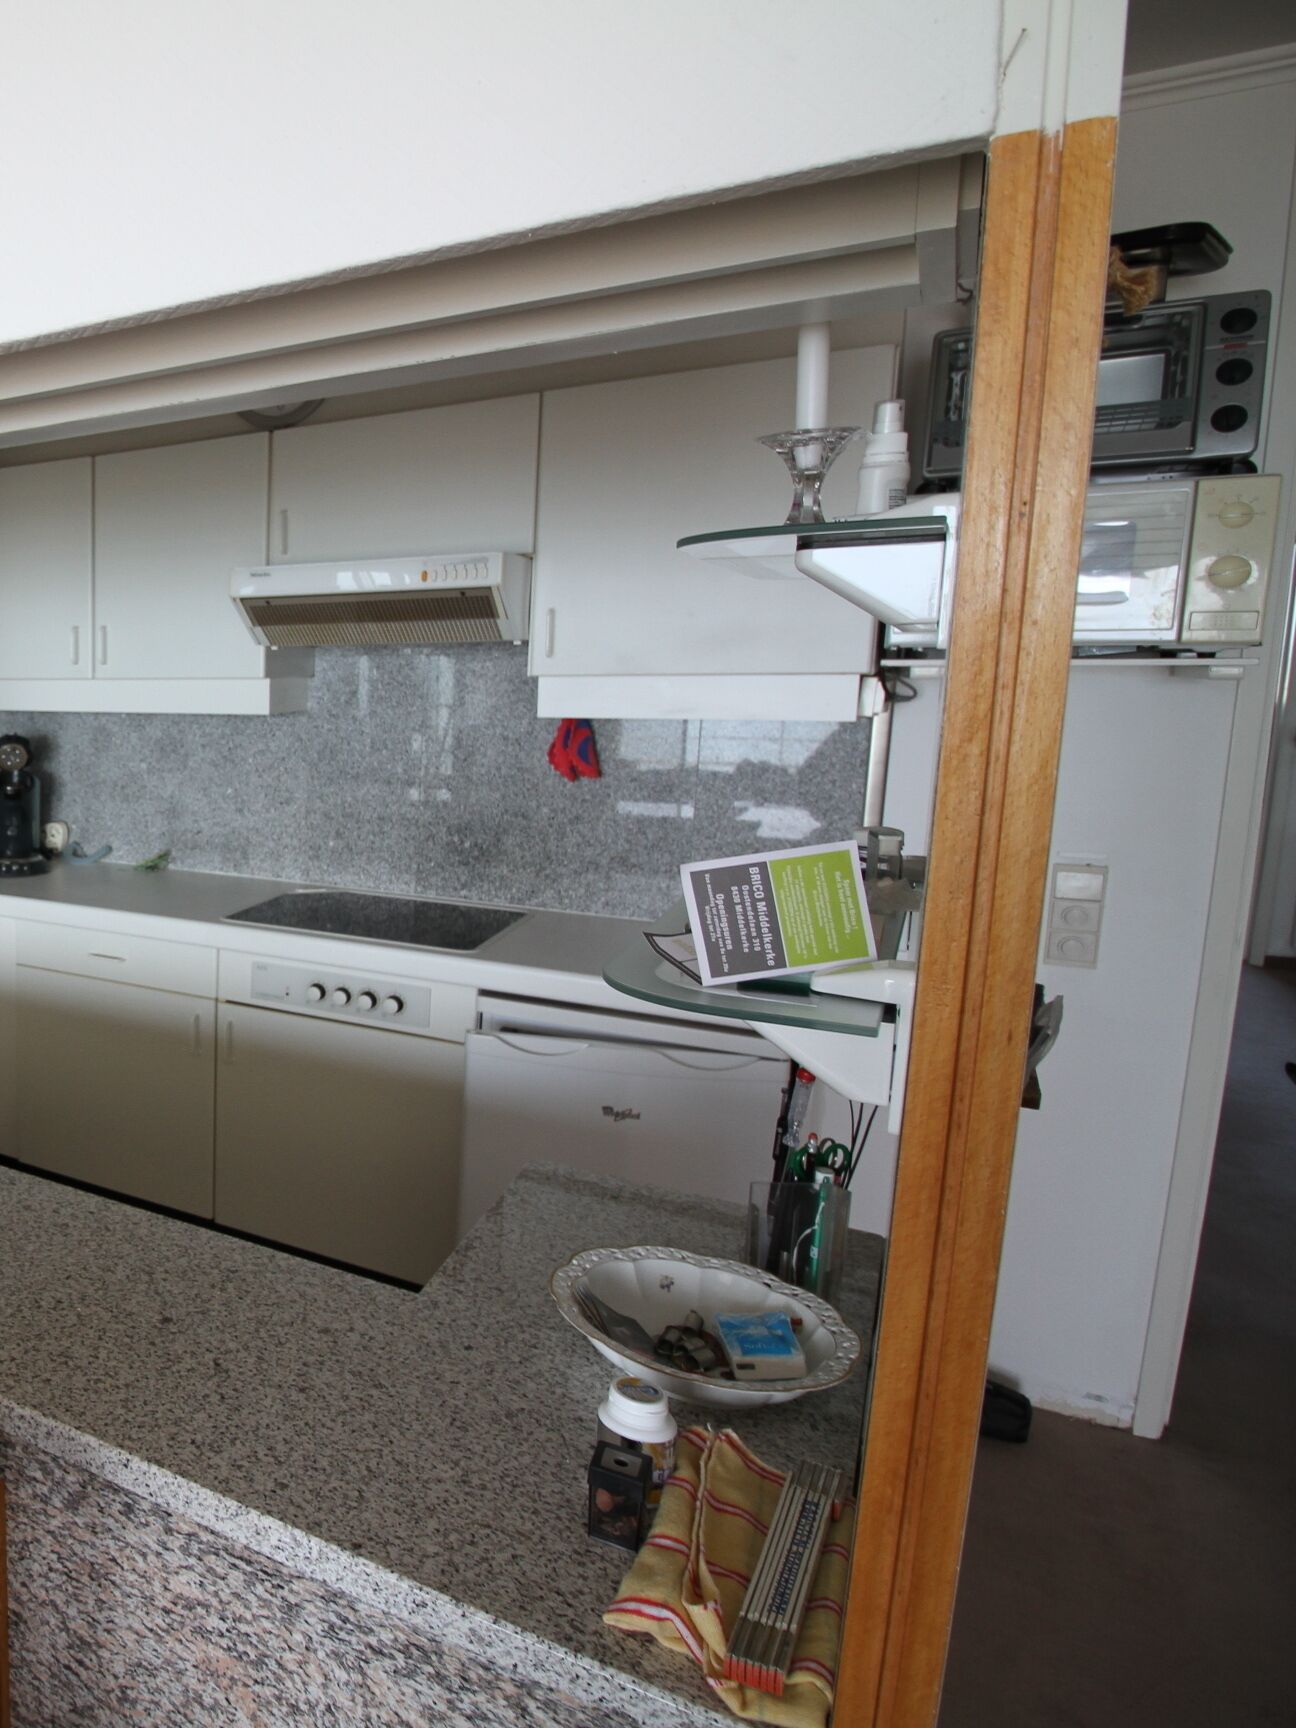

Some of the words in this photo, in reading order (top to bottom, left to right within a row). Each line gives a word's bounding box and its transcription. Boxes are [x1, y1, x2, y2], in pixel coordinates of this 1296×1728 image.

[715, 893, 732, 950] Openingsuren
[735, 904, 749, 952] Middelkerke
[742, 884, 757, 936] Oostendelaan
[751, 937, 761, 951] 310
[748, 866, 764, 899] BRICO
[757, 901, 775, 966] Middelkerke
